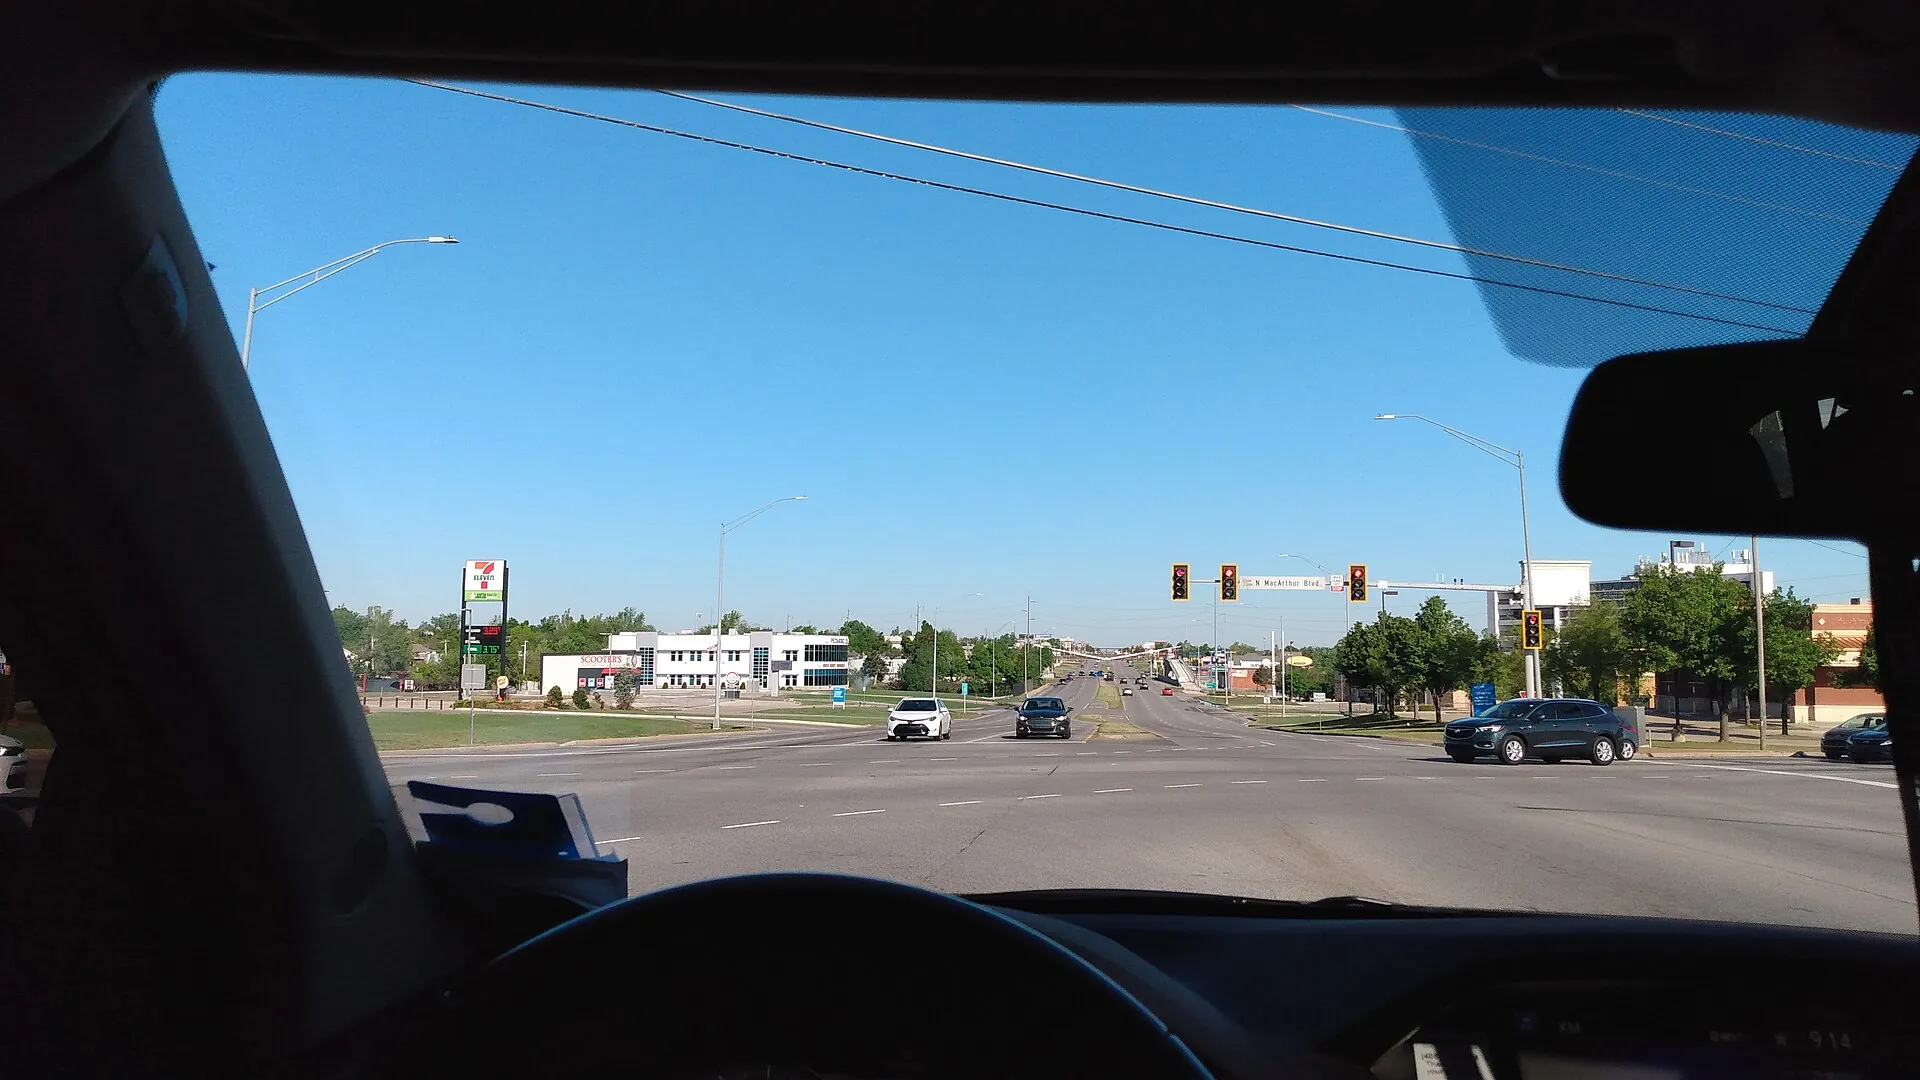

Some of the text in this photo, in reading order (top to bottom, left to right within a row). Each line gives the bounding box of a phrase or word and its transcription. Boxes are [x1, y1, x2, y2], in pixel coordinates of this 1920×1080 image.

[474, 562, 494, 574] 7
[1264, 579, 1299, 587] MacArthur
[581, 655, 622, 663] SCOOTER'S
